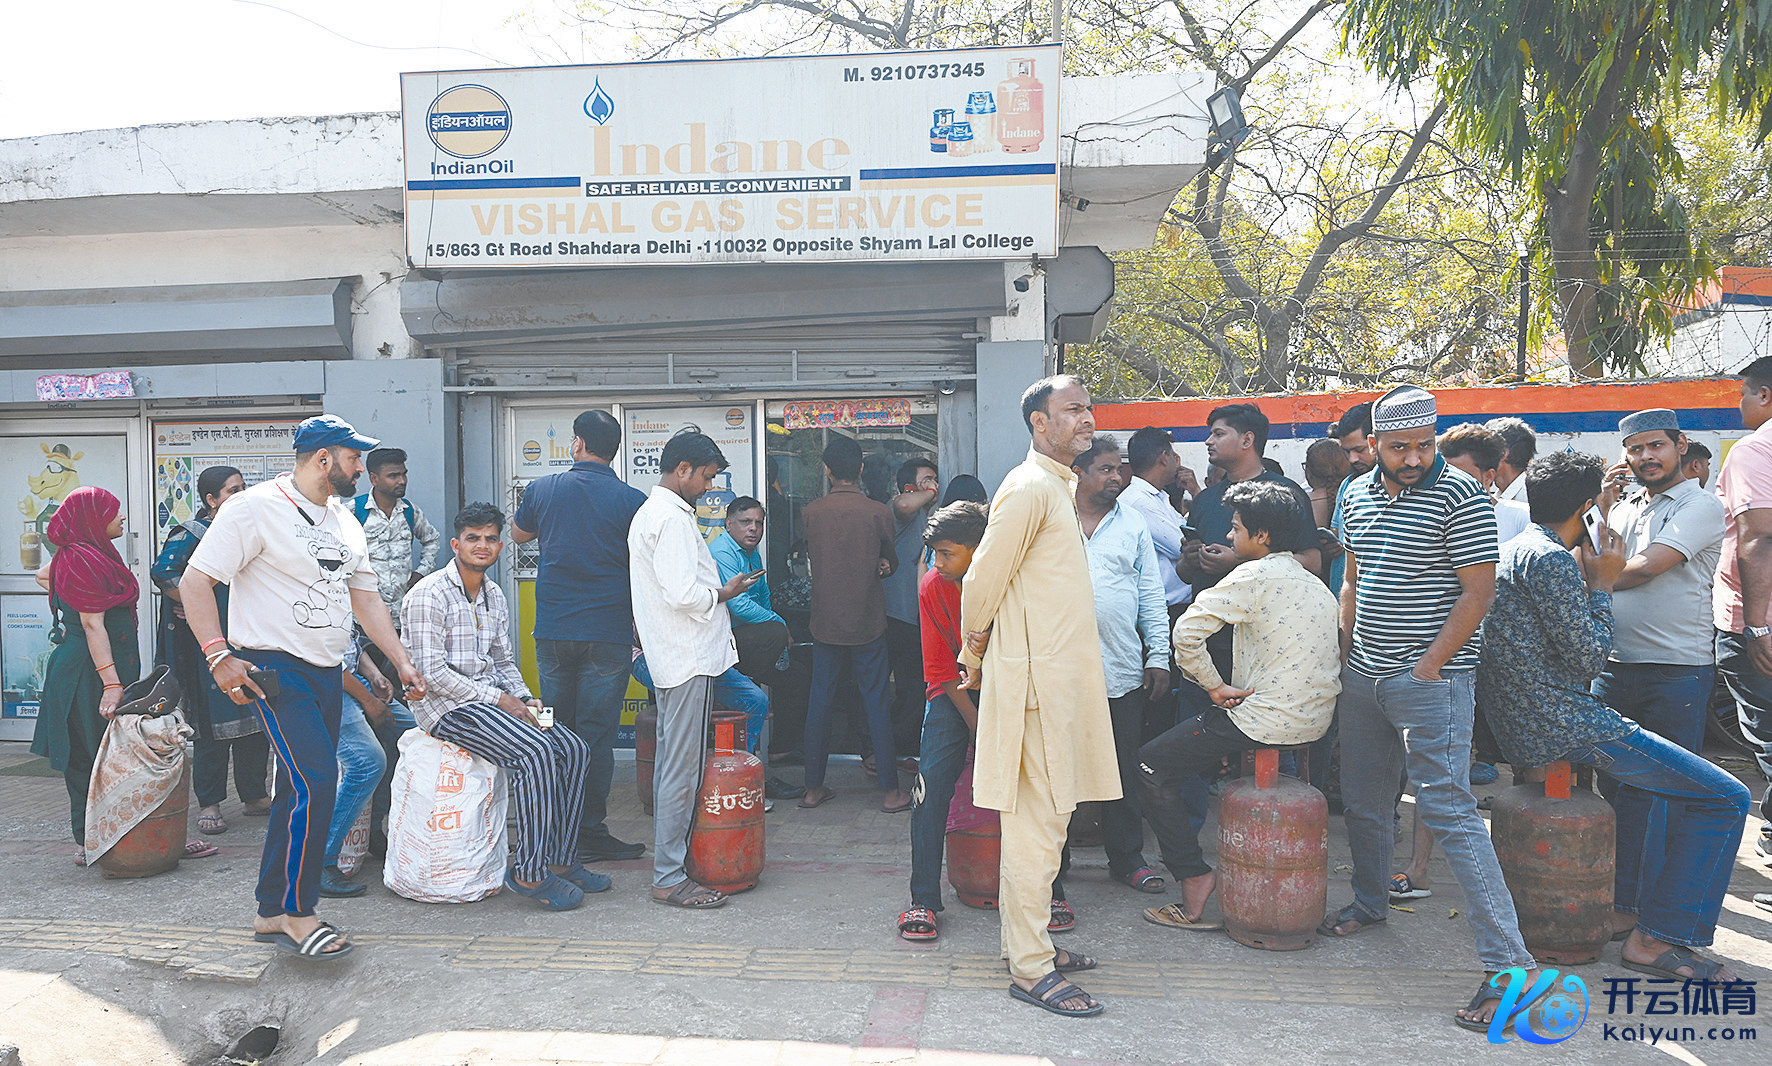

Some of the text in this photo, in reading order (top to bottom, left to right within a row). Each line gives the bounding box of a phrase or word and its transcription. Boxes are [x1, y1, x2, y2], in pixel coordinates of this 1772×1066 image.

[844, 62, 985, 82] M. 9210737345
[431, 113, 507, 130] इंडियनऑयल
[589, 123, 851, 177] Indane
[431, 160, 514, 175] IndianOil
[470, 194, 984, 236] VISHAL GAS SERVICE
[427, 243, 481, 258] 15/863
[485, 244, 505, 257] Gt
[510, 241, 551, 256] Road
[557, 240, 641, 256] Shahdara
[646, 239, 692, 254] Delhi
[772, 237, 854, 255] Opposite
[859, 235, 922, 254] Shyam
[928, 234, 956, 250] Lal
[962, 233, 1034, 251] College
